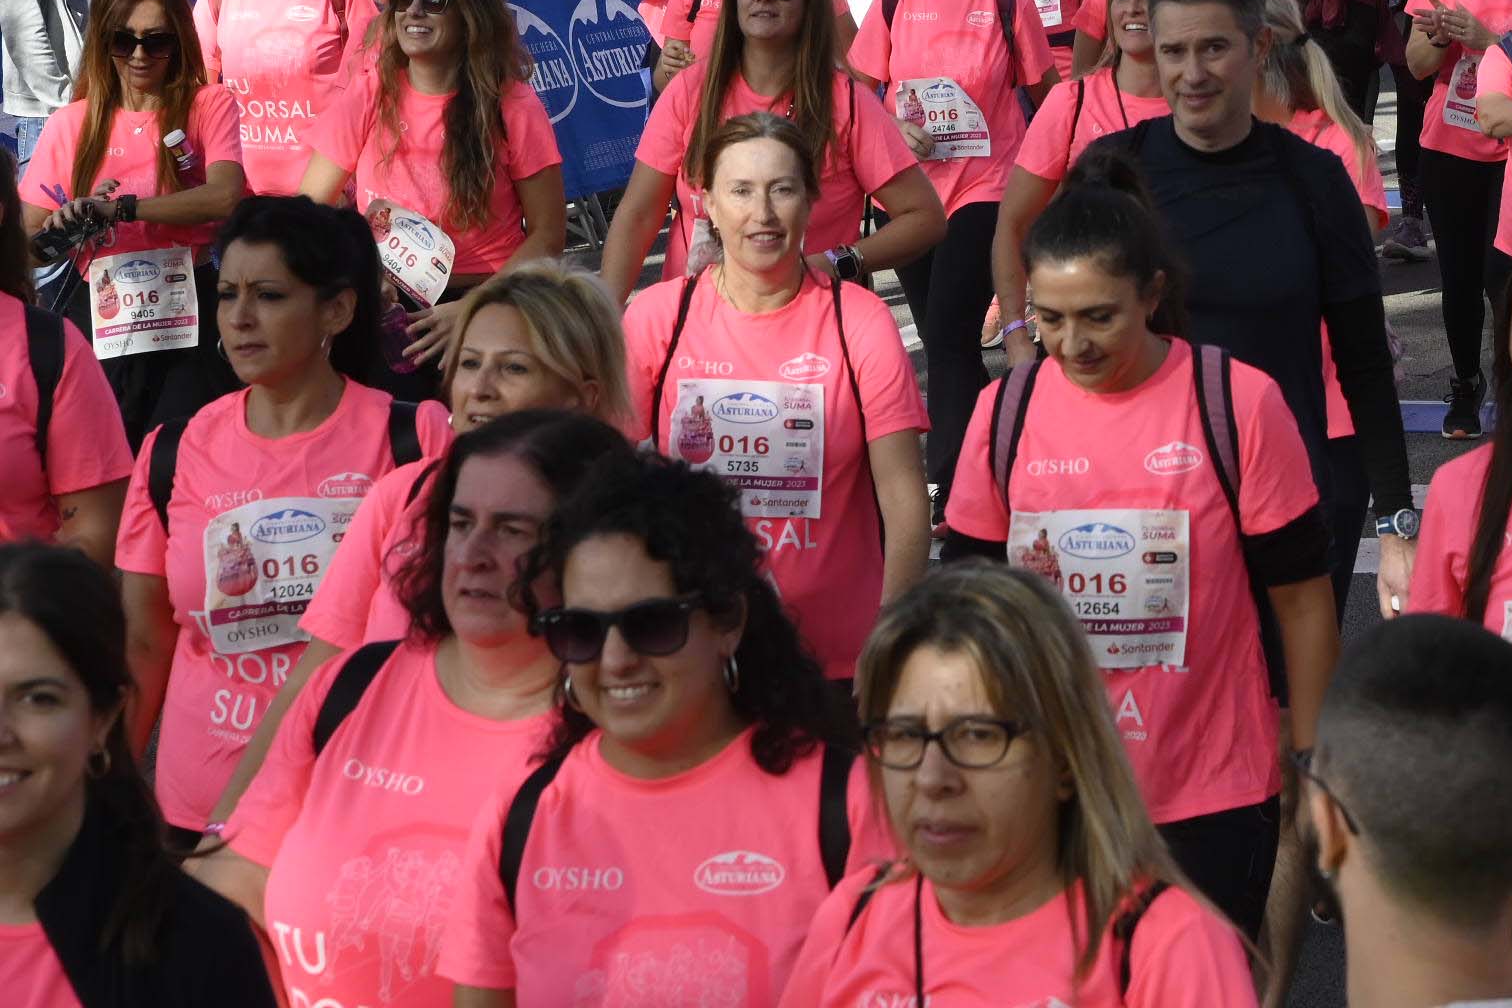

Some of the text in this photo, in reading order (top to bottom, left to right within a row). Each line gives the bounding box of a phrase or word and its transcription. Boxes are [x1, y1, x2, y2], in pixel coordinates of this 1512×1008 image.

[903, 11, 938, 21] OYSHO
[928, 108, 959, 122] 016
[1450, 113, 1476, 126] OYSHO
[240, 124, 298, 143] SUMA
[932, 123, 956, 133] 24746
[388, 236, 418, 268] 016
[383, 253, 402, 274] 9404
[119, 268, 158, 280] ASTURIANA
[123, 290, 159, 307] 016
[130, 309, 155, 320] 9405
[104, 325, 131, 335] CARRERA
[717, 403, 774, 418] ASTURIANA
[783, 401, 812, 411] SUMA
[718, 434, 770, 456] 016
[727, 460, 759, 472] 5735
[1150, 454, 1199, 470] ASTURIANA
[740, 479, 751, 487] LA
[753, 479, 783, 487] MUJER
[786, 480, 807, 488] 2023
[762, 496, 809, 508] Santander
[257, 523, 320, 538] ASTURIANA
[1142, 531, 1176, 541] SUMA
[1063, 536, 1130, 551] ASTURIANA
[262, 553, 319, 580] 016
[269, 582, 314, 599] 12024
[1068, 572, 1127, 594] 016
[1075, 600, 1120, 616] 12654
[228, 623, 279, 643] OYSHO
[1094, 622, 1107, 632] LA
[1110, 622, 1145, 632] MUJER
[1149, 621, 1171, 630] 2023
[1121, 642, 1175, 655] Santander
[342, 755, 424, 796] OYSHO
[533, 866, 624, 891] OYSHO
[699, 867, 778, 888] ASTURIANA
[273, 921, 327, 974] TU
